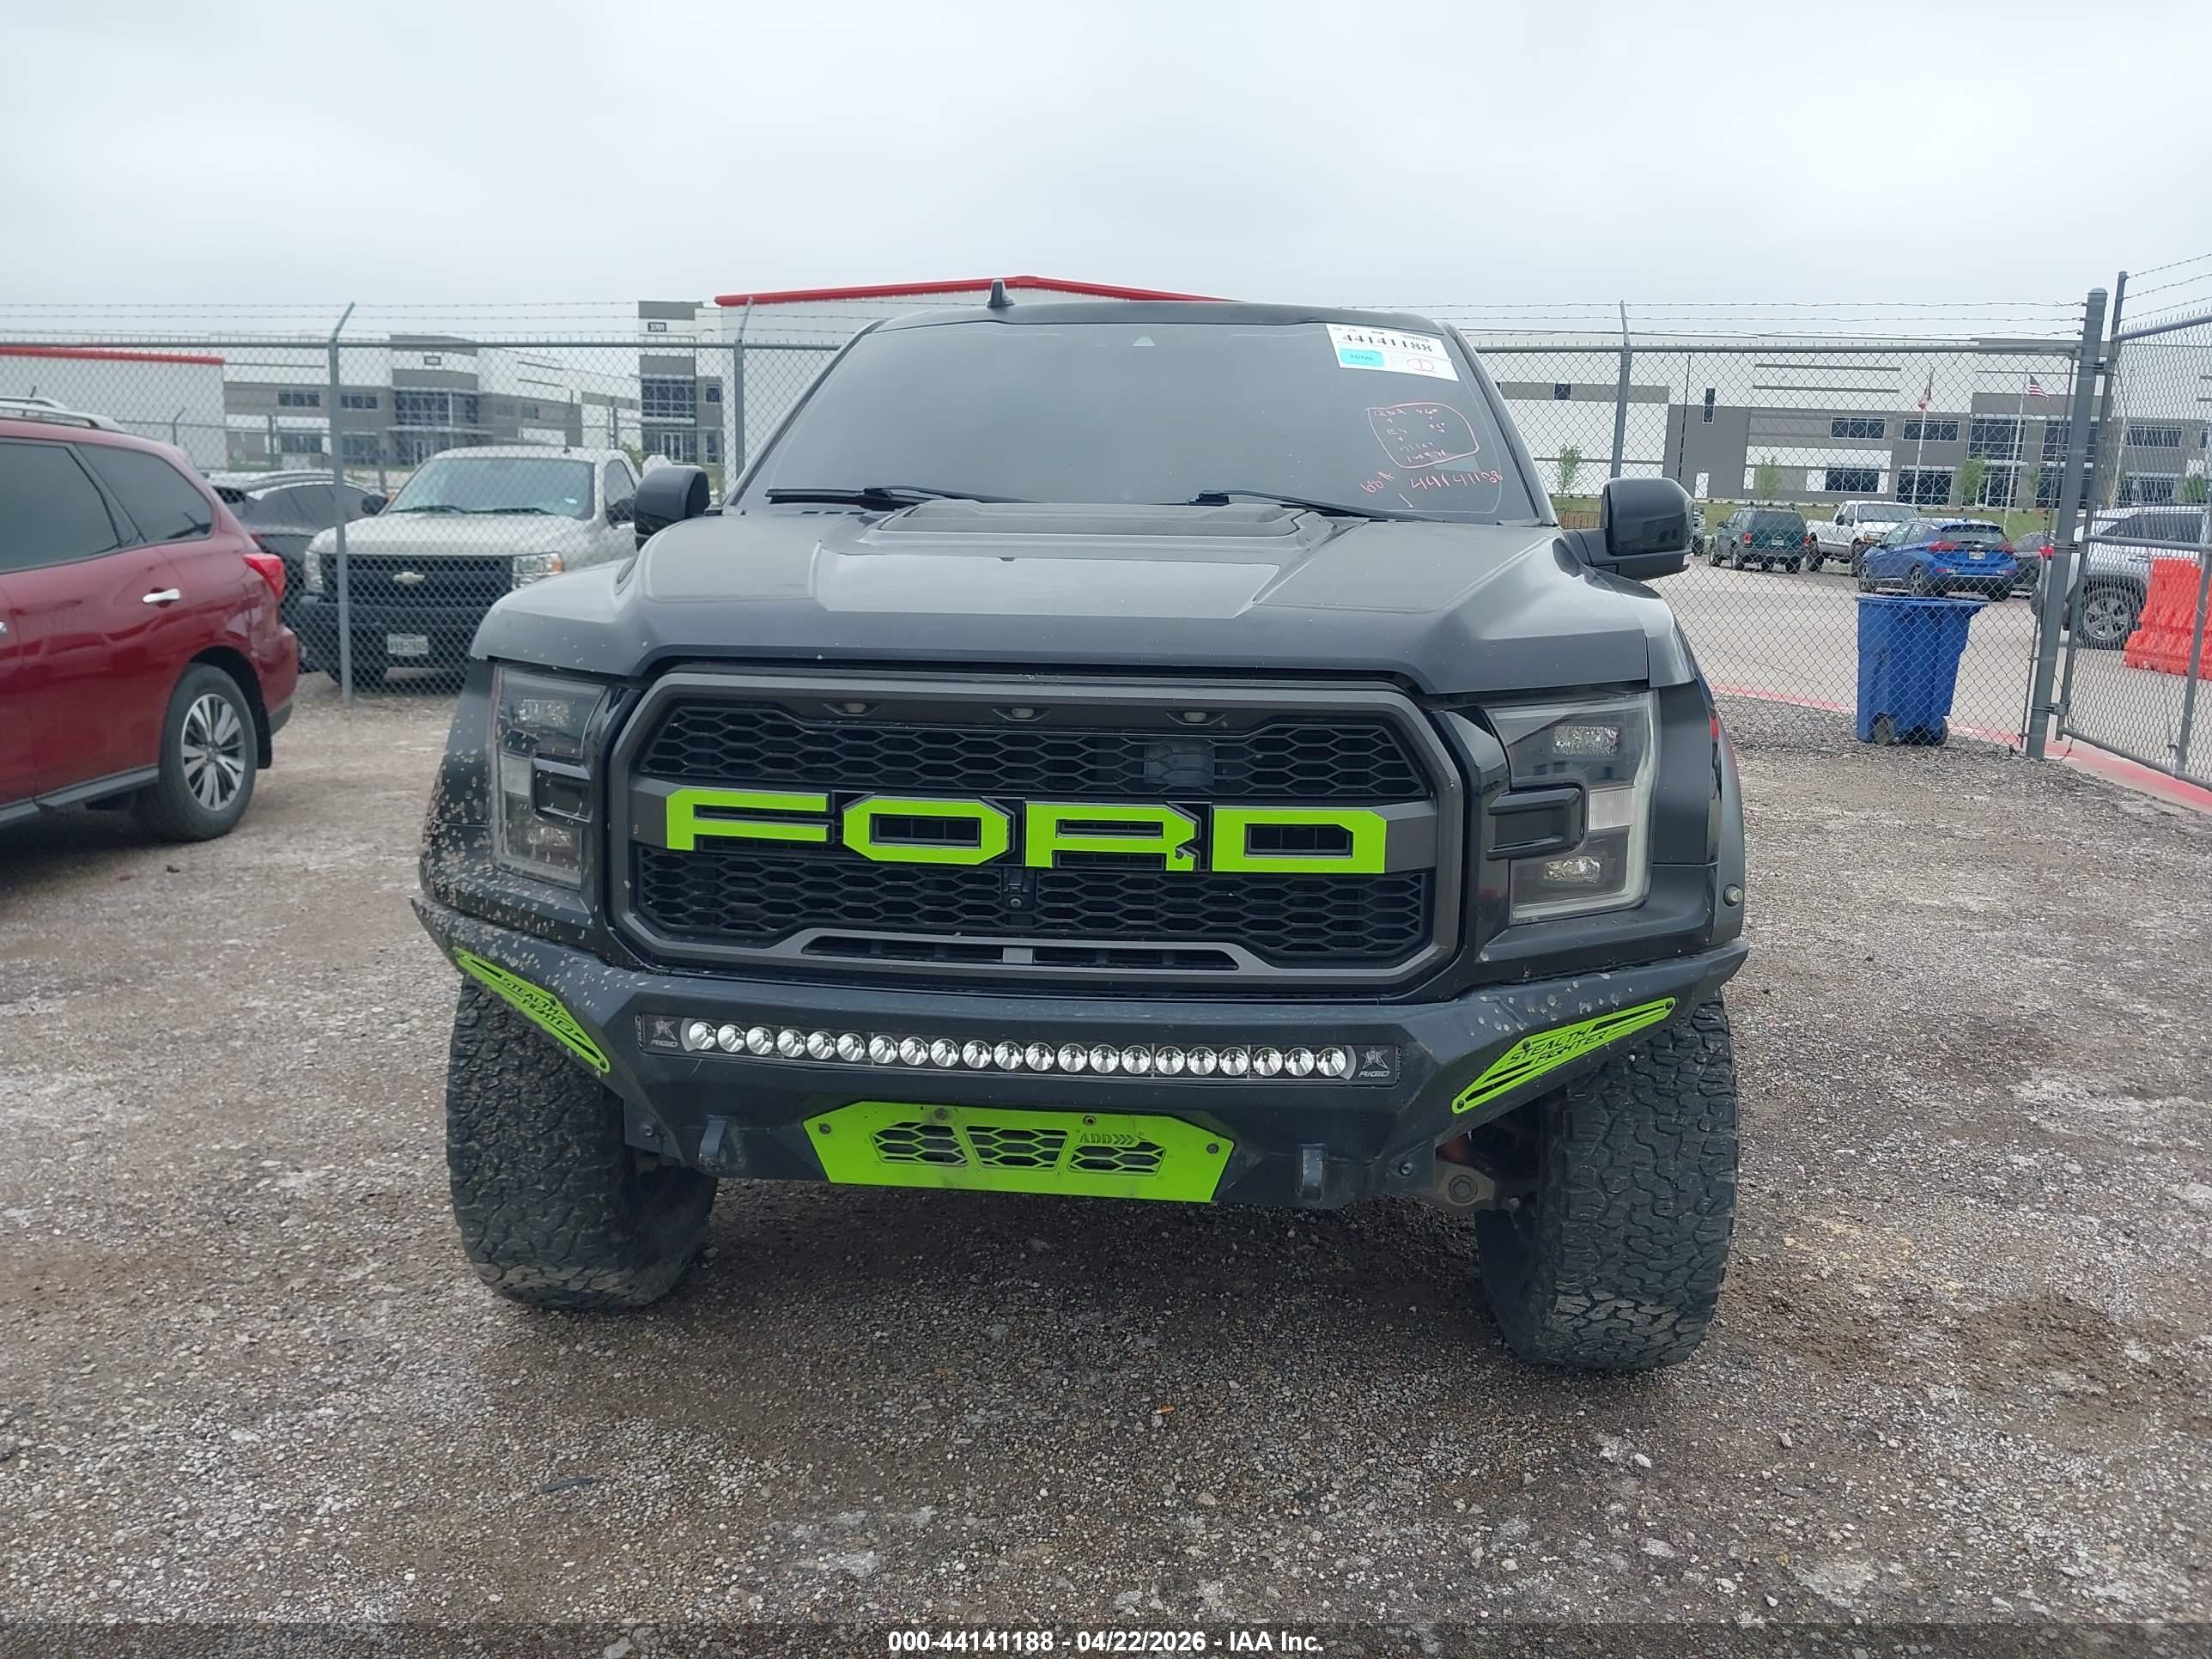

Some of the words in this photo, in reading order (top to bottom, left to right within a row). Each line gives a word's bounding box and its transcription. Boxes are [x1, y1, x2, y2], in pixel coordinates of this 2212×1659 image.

[1343, 334, 1433, 352] 44141188
[666, 788, 1387, 874] FORD
[500, 976, 562, 1016] STEALTH
[650, 1039, 678, 1048] RIGID
[1509, 1026, 1591, 1063] STEALTH
[1534, 1030, 1608, 1064] FIGHTER
[1080, 1133, 1113, 1144] ADD
